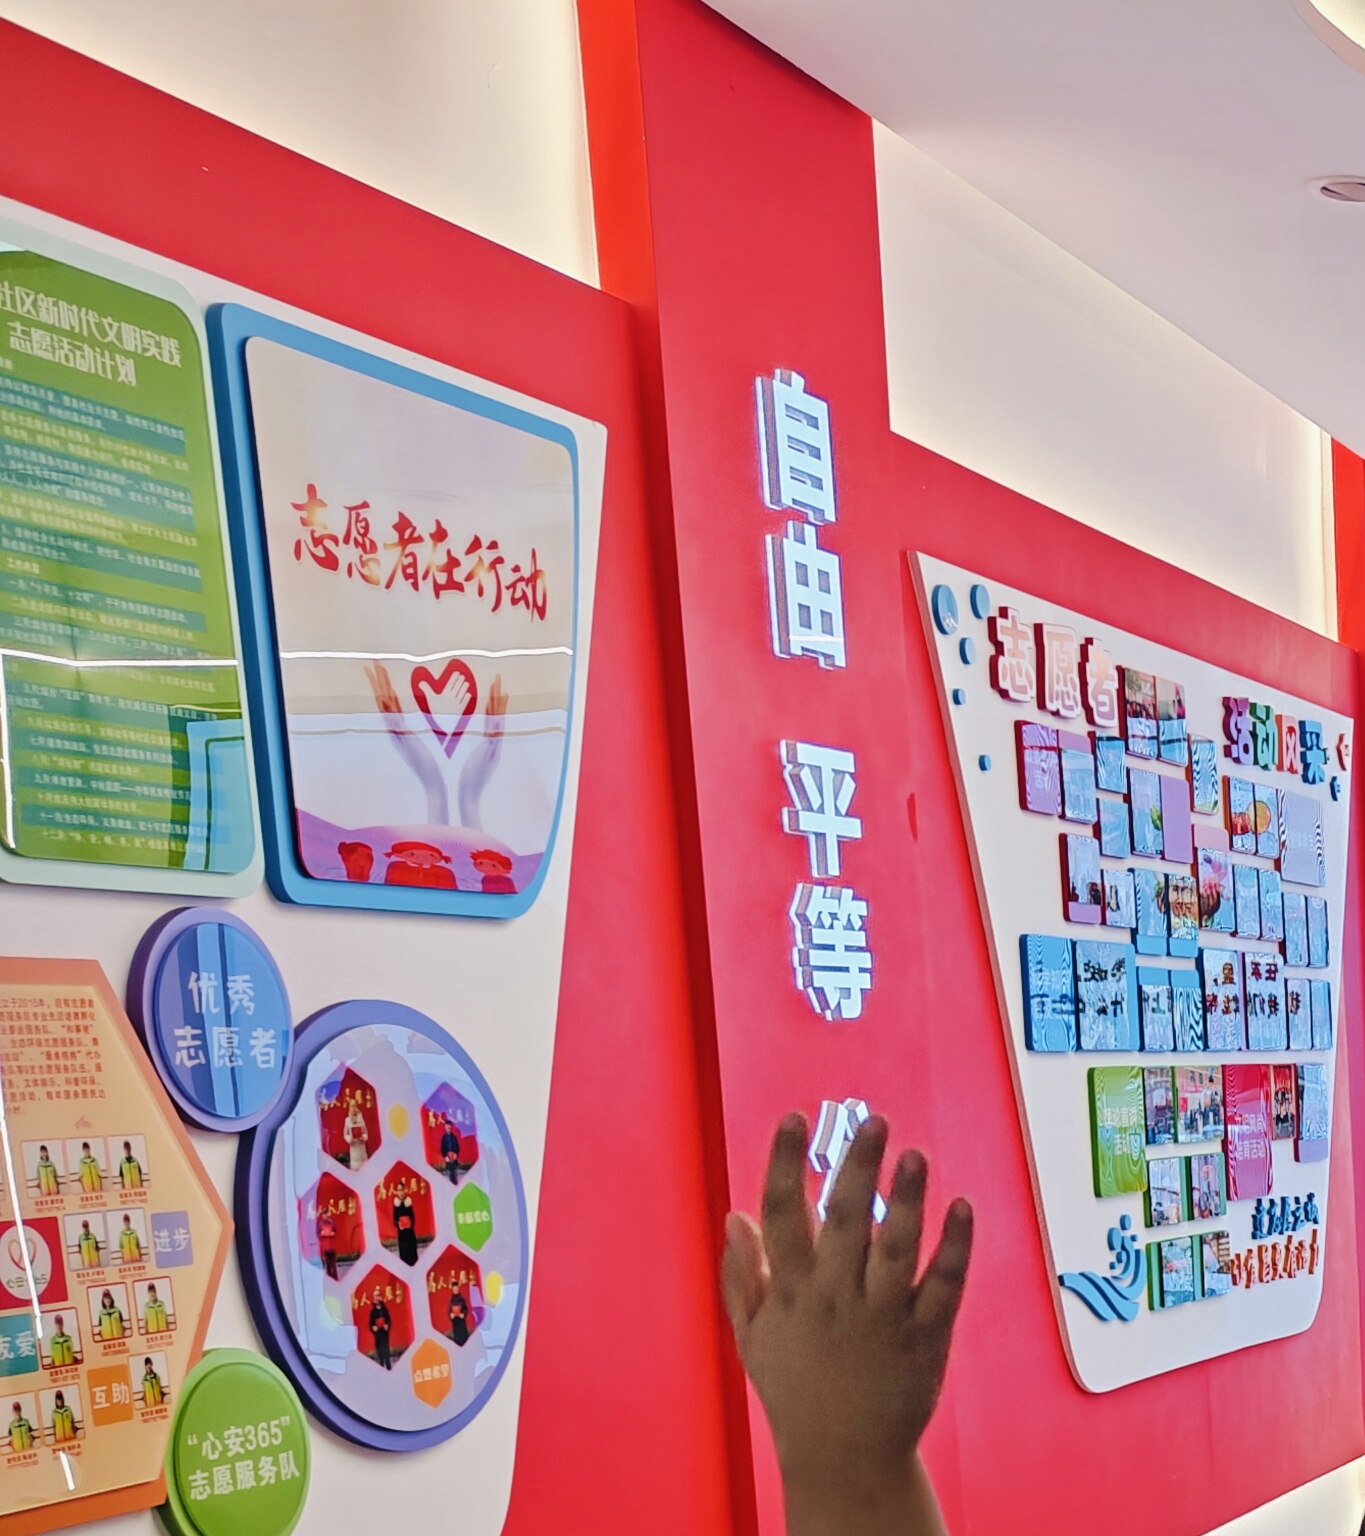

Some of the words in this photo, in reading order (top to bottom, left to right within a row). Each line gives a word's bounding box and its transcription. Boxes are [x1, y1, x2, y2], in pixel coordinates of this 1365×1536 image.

[7, 321, 137, 387] 志愿活动计划
[757, 368, 849, 670] 自由
[290, 483, 547, 623] 志愿者在行动
[987, 606, 1119, 728] 志愿者
[1222, 696, 1328, 786] 活动风采
[780, 738, 875, 1021] 平等
[188, 971, 256, 1016] 优秀
[174, 1025, 277, 1069] 志愿者
[153, 1227, 190, 1253] 进步
[91, 1380, 131, 1410] 互助
[188, 1450, 300, 1500] 志愿服务队
